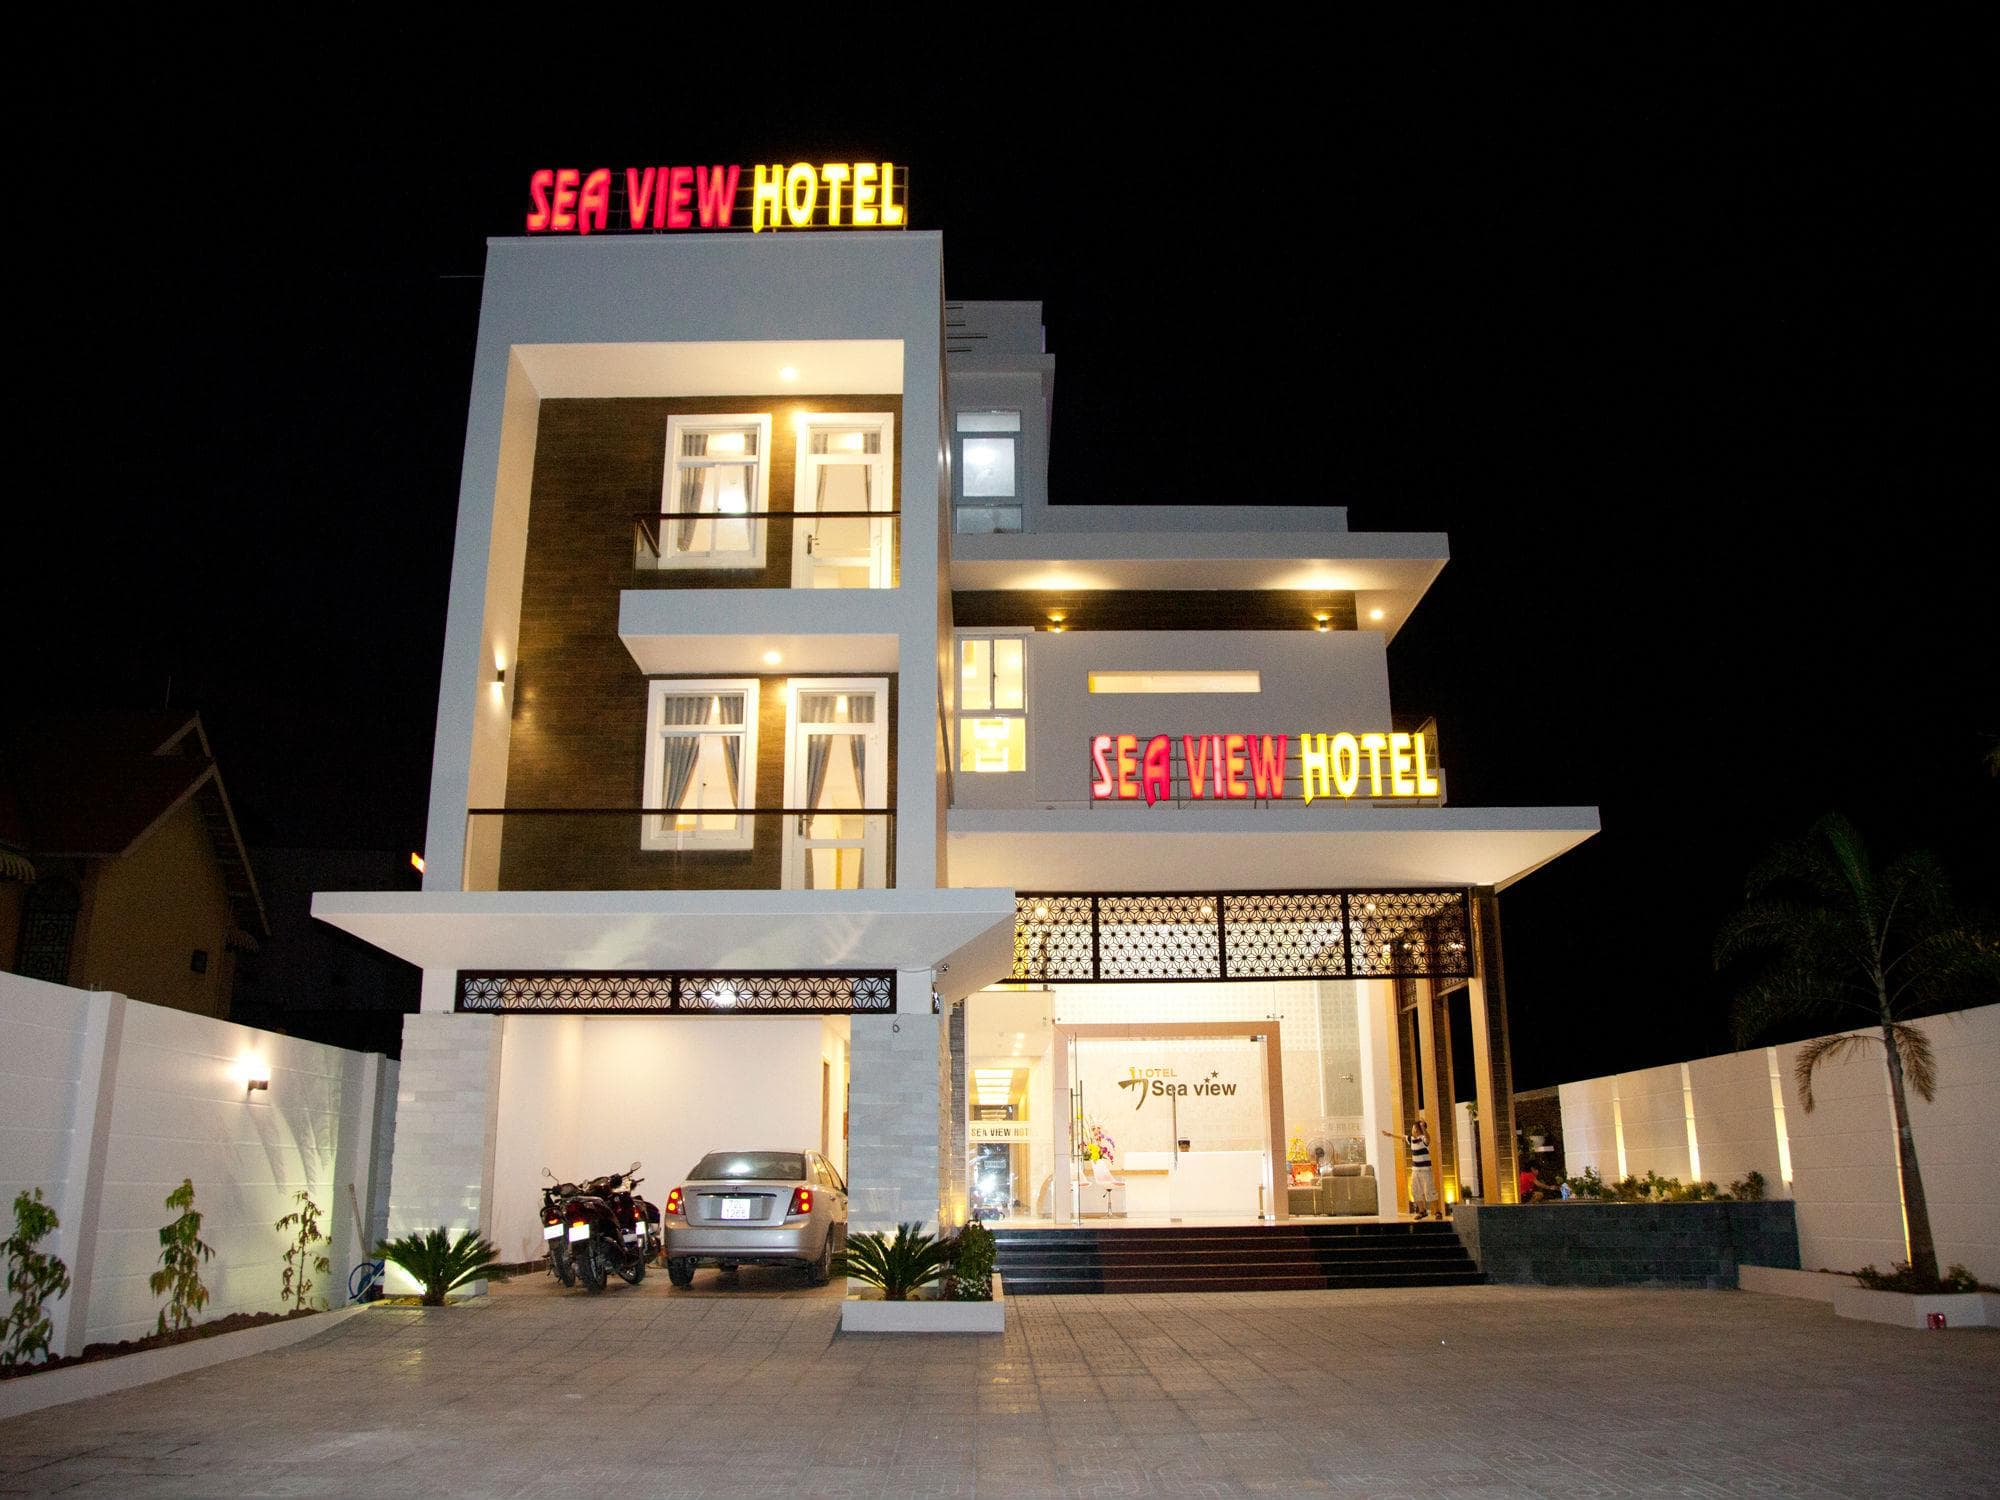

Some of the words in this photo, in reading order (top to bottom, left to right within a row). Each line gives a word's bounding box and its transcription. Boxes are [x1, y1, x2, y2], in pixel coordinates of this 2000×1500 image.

[526, 167, 611, 234] SEA
[626, 164, 741, 229] VIEW
[751, 162, 904, 233] HOTEL
[1092, 733, 1171, 807] SEA
[1182, 733, 1289, 799] VIEW
[1300, 732, 1438, 806] HOTEL
[1151, 1080, 1188, 1097] Sea
[1193, 1080, 1237, 1097] view
[971, 1127, 988, 1137] SEA
[990, 1127, 1011, 1137] VIEW
